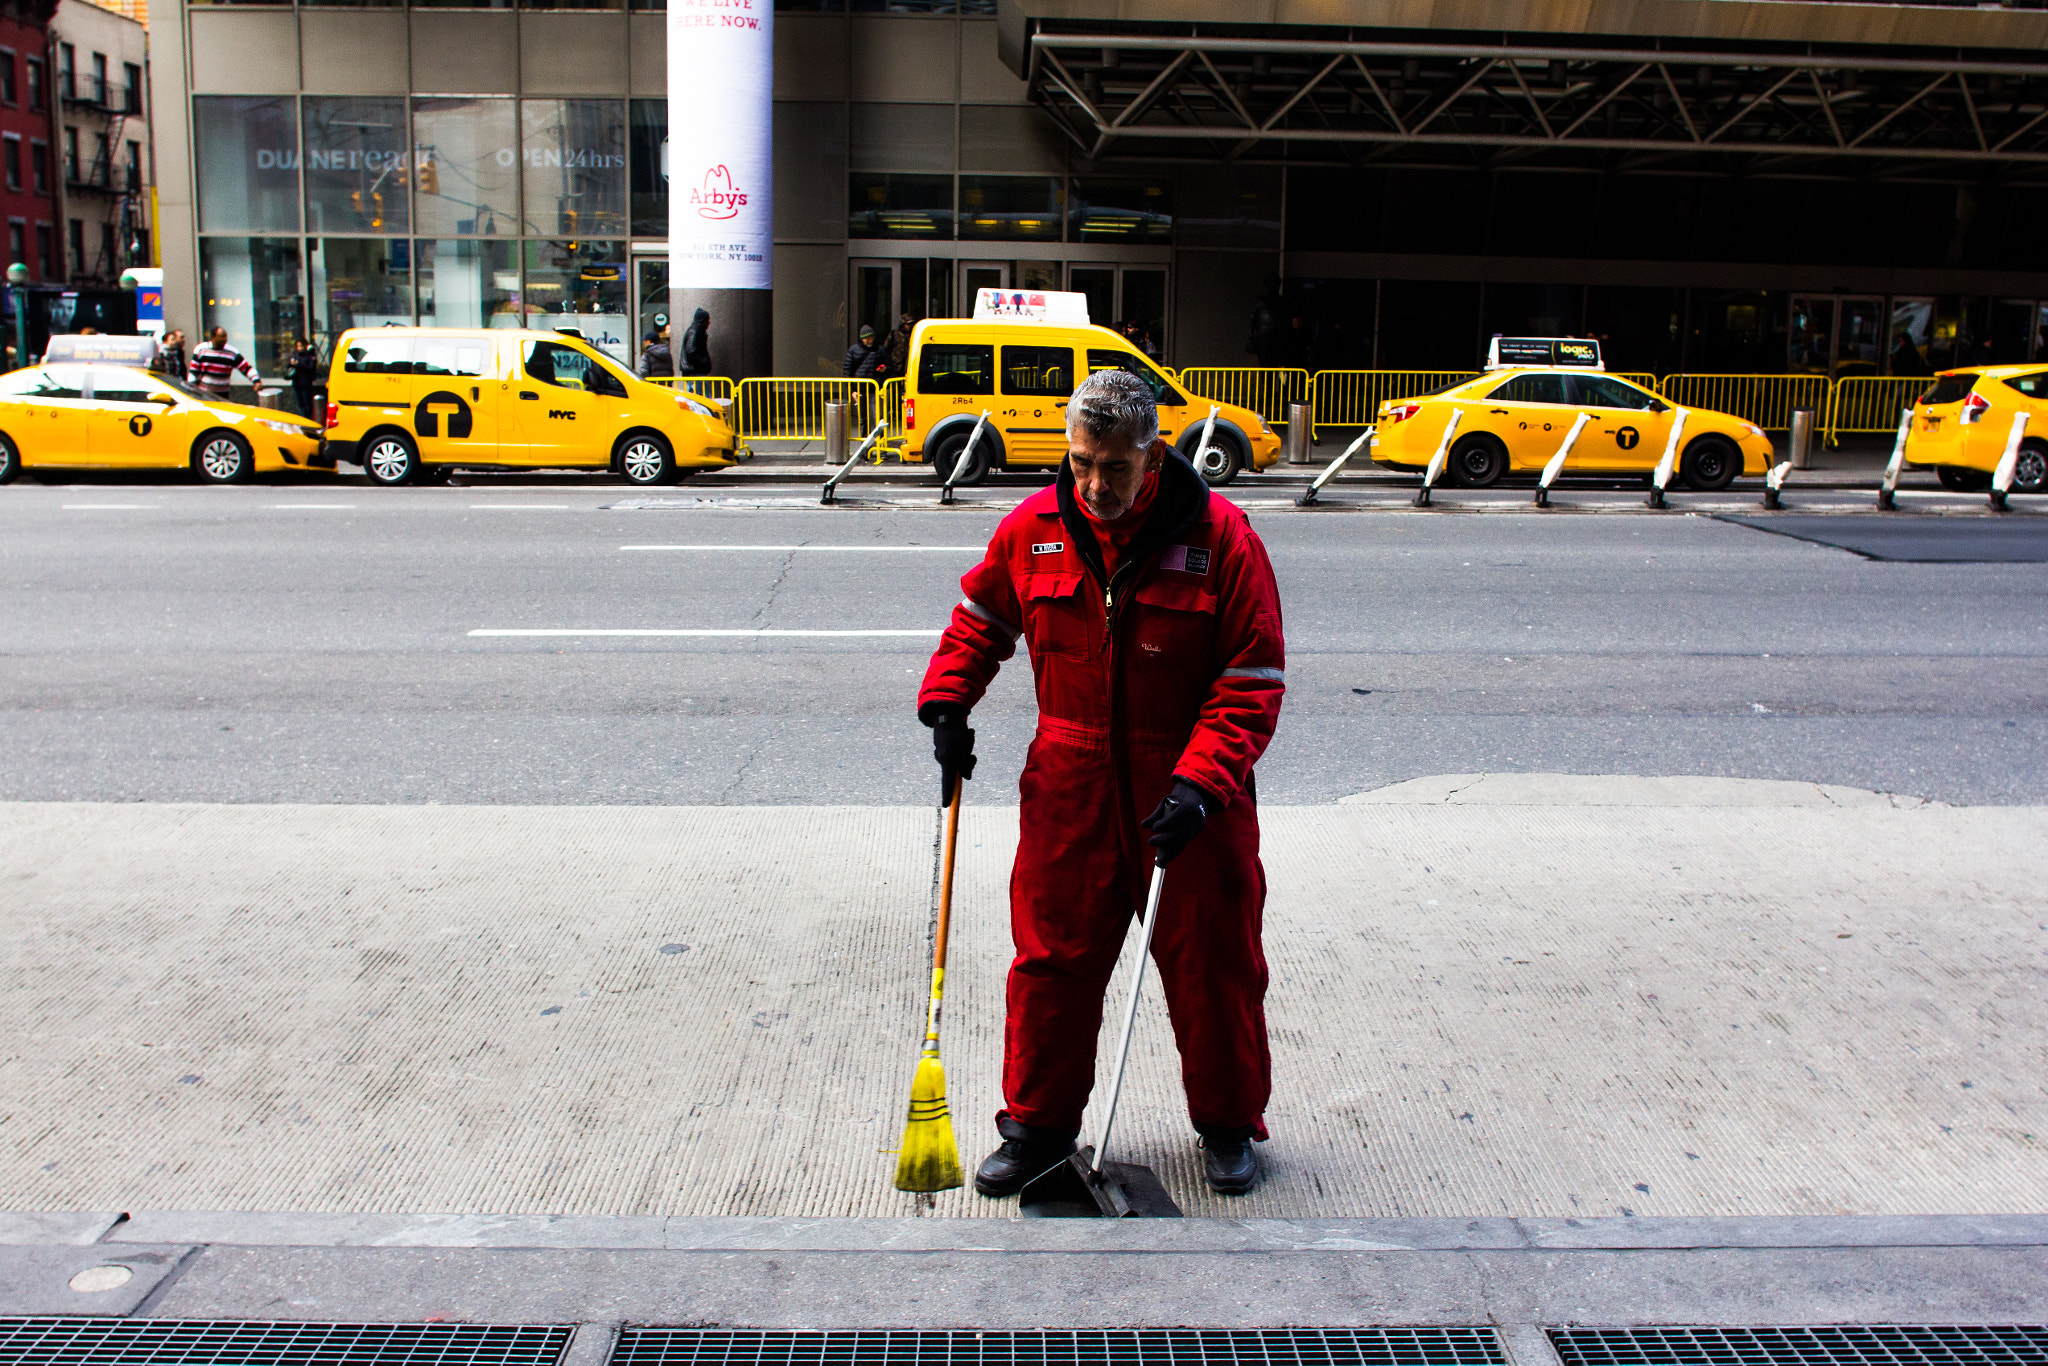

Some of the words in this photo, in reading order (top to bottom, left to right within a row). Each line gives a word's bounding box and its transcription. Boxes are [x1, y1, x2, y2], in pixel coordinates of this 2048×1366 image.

[714, 0, 753, 9] LIVE
[689, 187, 747, 209] Arby's
[728, 244, 747, 252] AVE
[728, 253, 742, 261] NY
[549, 410, 576, 420] NYC
